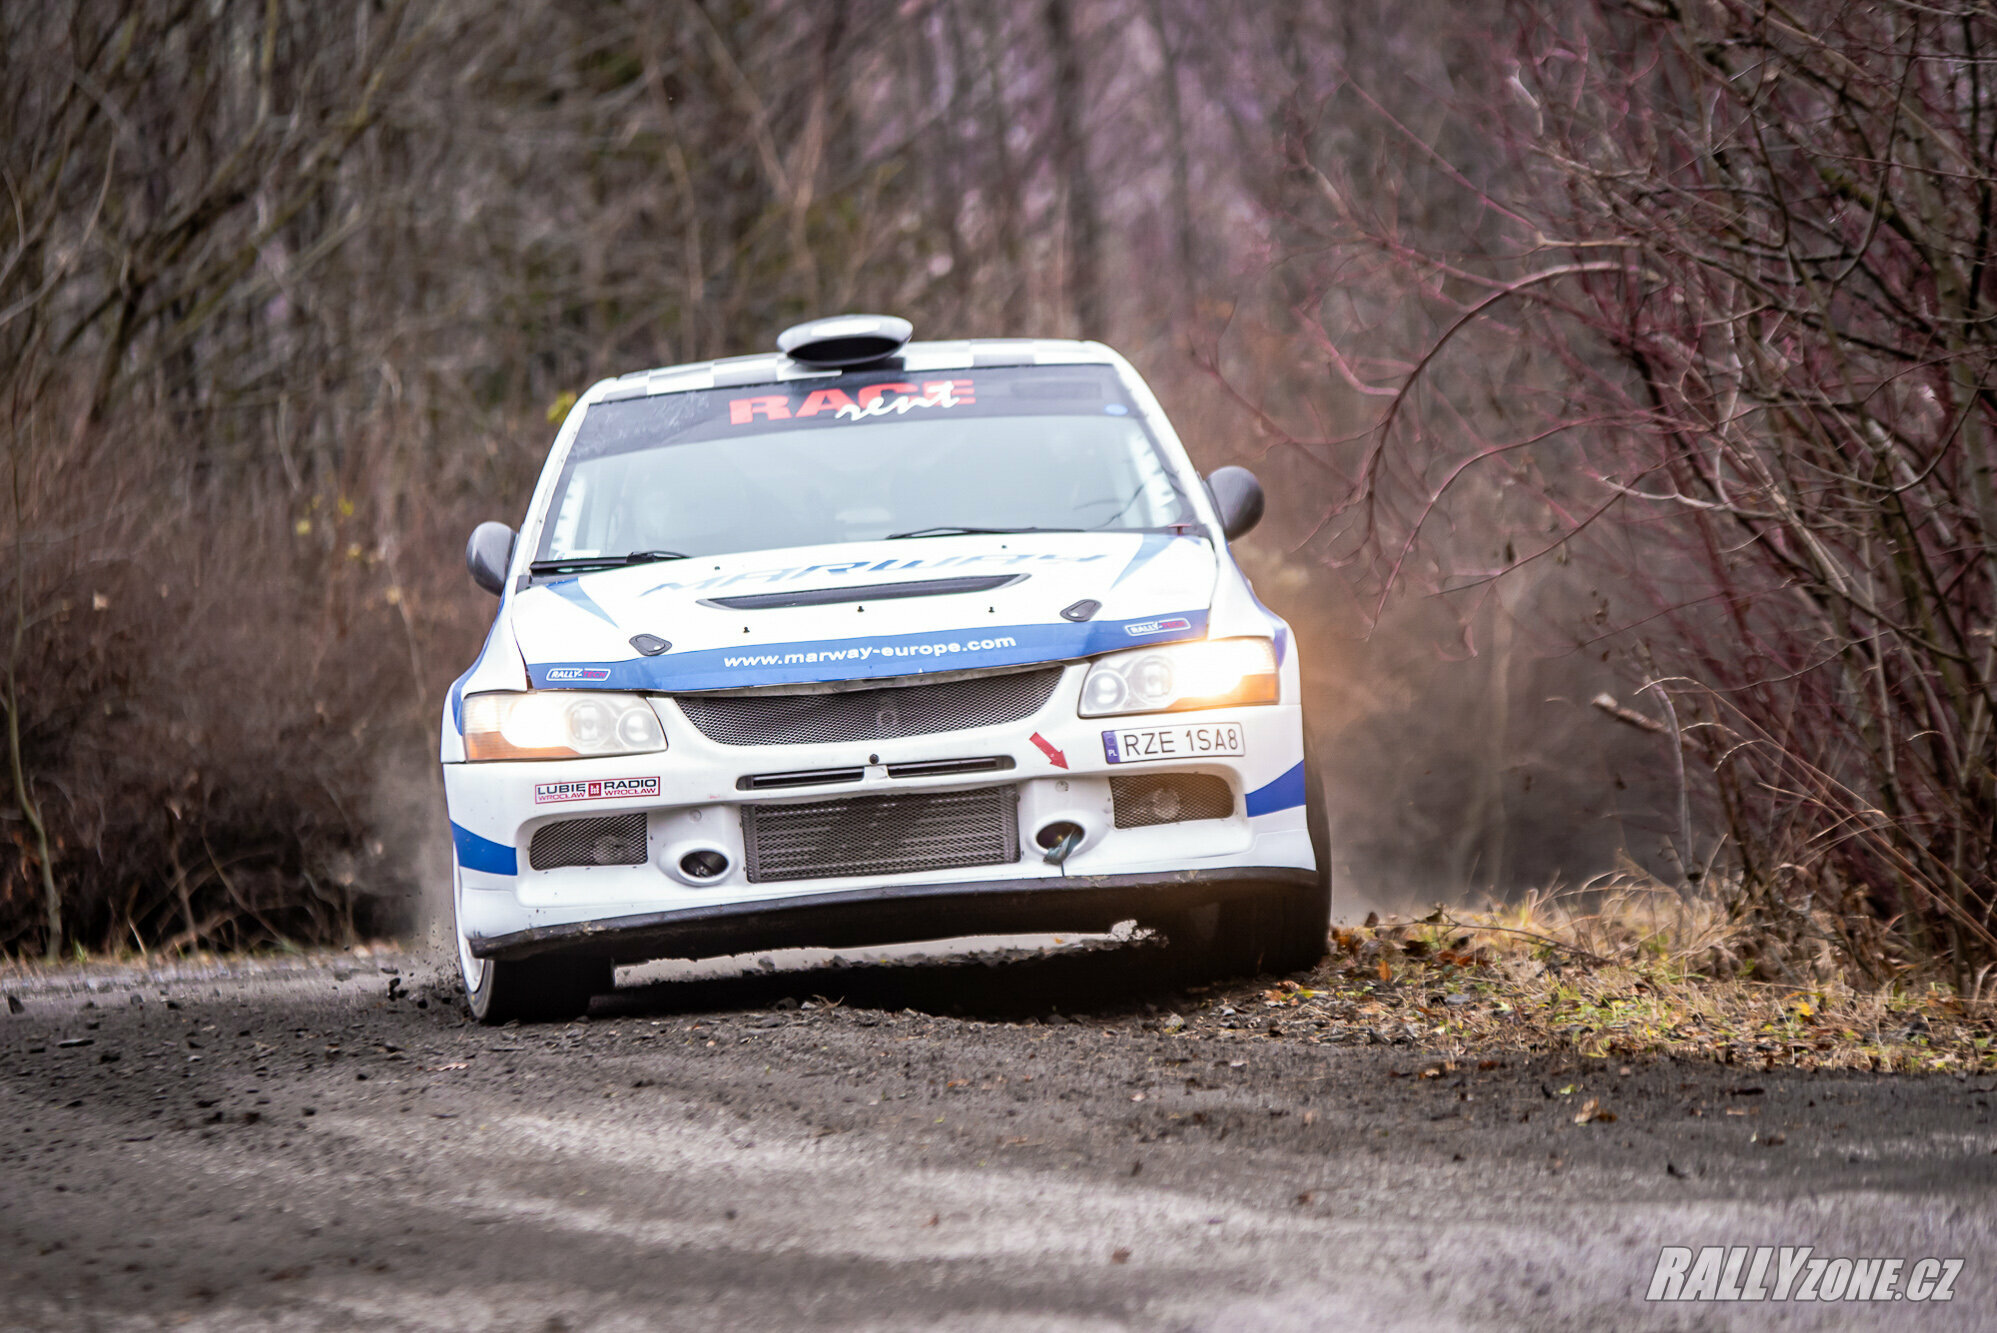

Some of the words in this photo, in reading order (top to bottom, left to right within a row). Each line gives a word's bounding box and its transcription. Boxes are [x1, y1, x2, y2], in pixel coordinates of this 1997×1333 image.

[729, 379, 976, 424] RACE
[835, 381, 960, 421] rent
[724, 635, 1016, 668] www.marway-europe.com
[551, 669, 606, 678] RALLY-TECH
[1108, 749, 1117, 757] PL
[1123, 731, 1175, 756] RZE
[1186, 728, 1238, 751] 1SA8
[537, 783, 586, 794] LUBIE
[603, 778, 656, 790] RADIO
